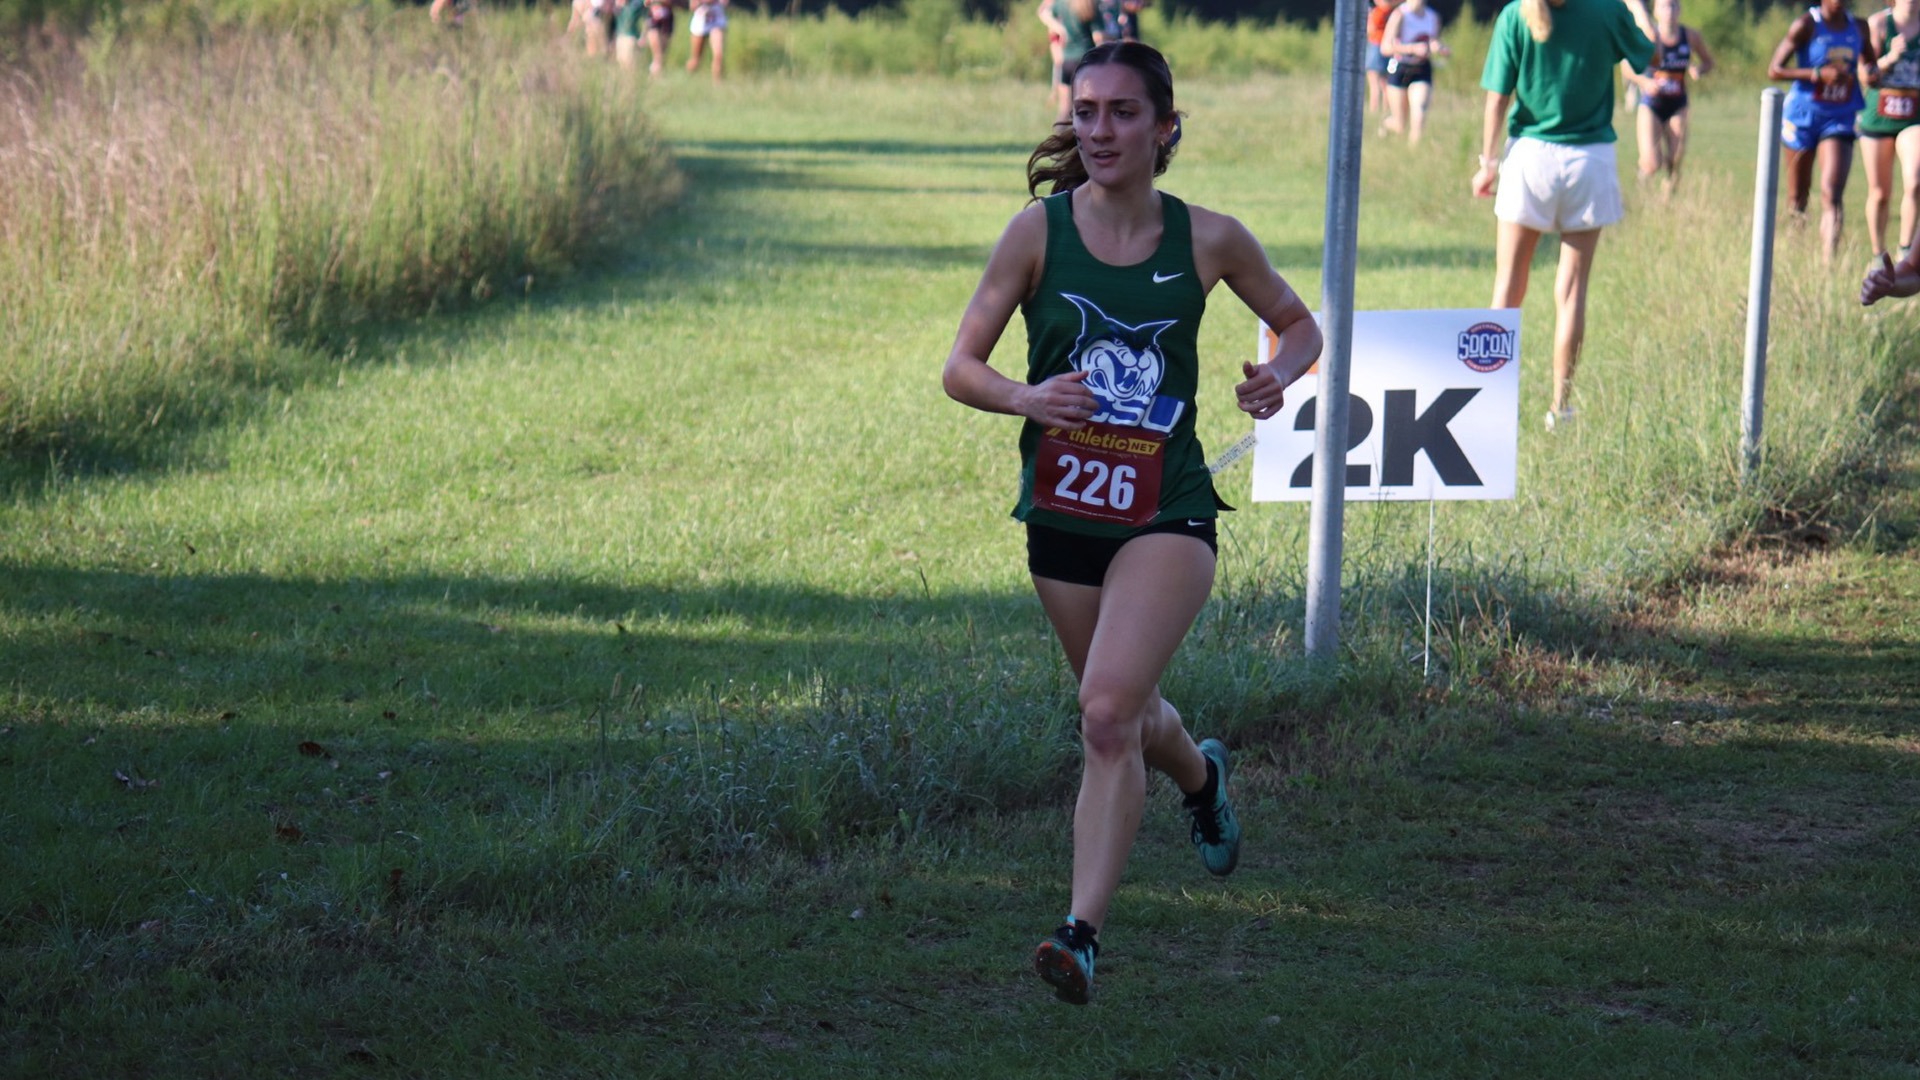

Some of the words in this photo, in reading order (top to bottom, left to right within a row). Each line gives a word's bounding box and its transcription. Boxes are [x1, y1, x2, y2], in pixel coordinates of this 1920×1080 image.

[1458, 331, 1514, 360] SOCON
[1046, 425, 1128, 451] thletic
[1289, 387, 1484, 488] 2K
[1054, 454, 1137, 510] 226
